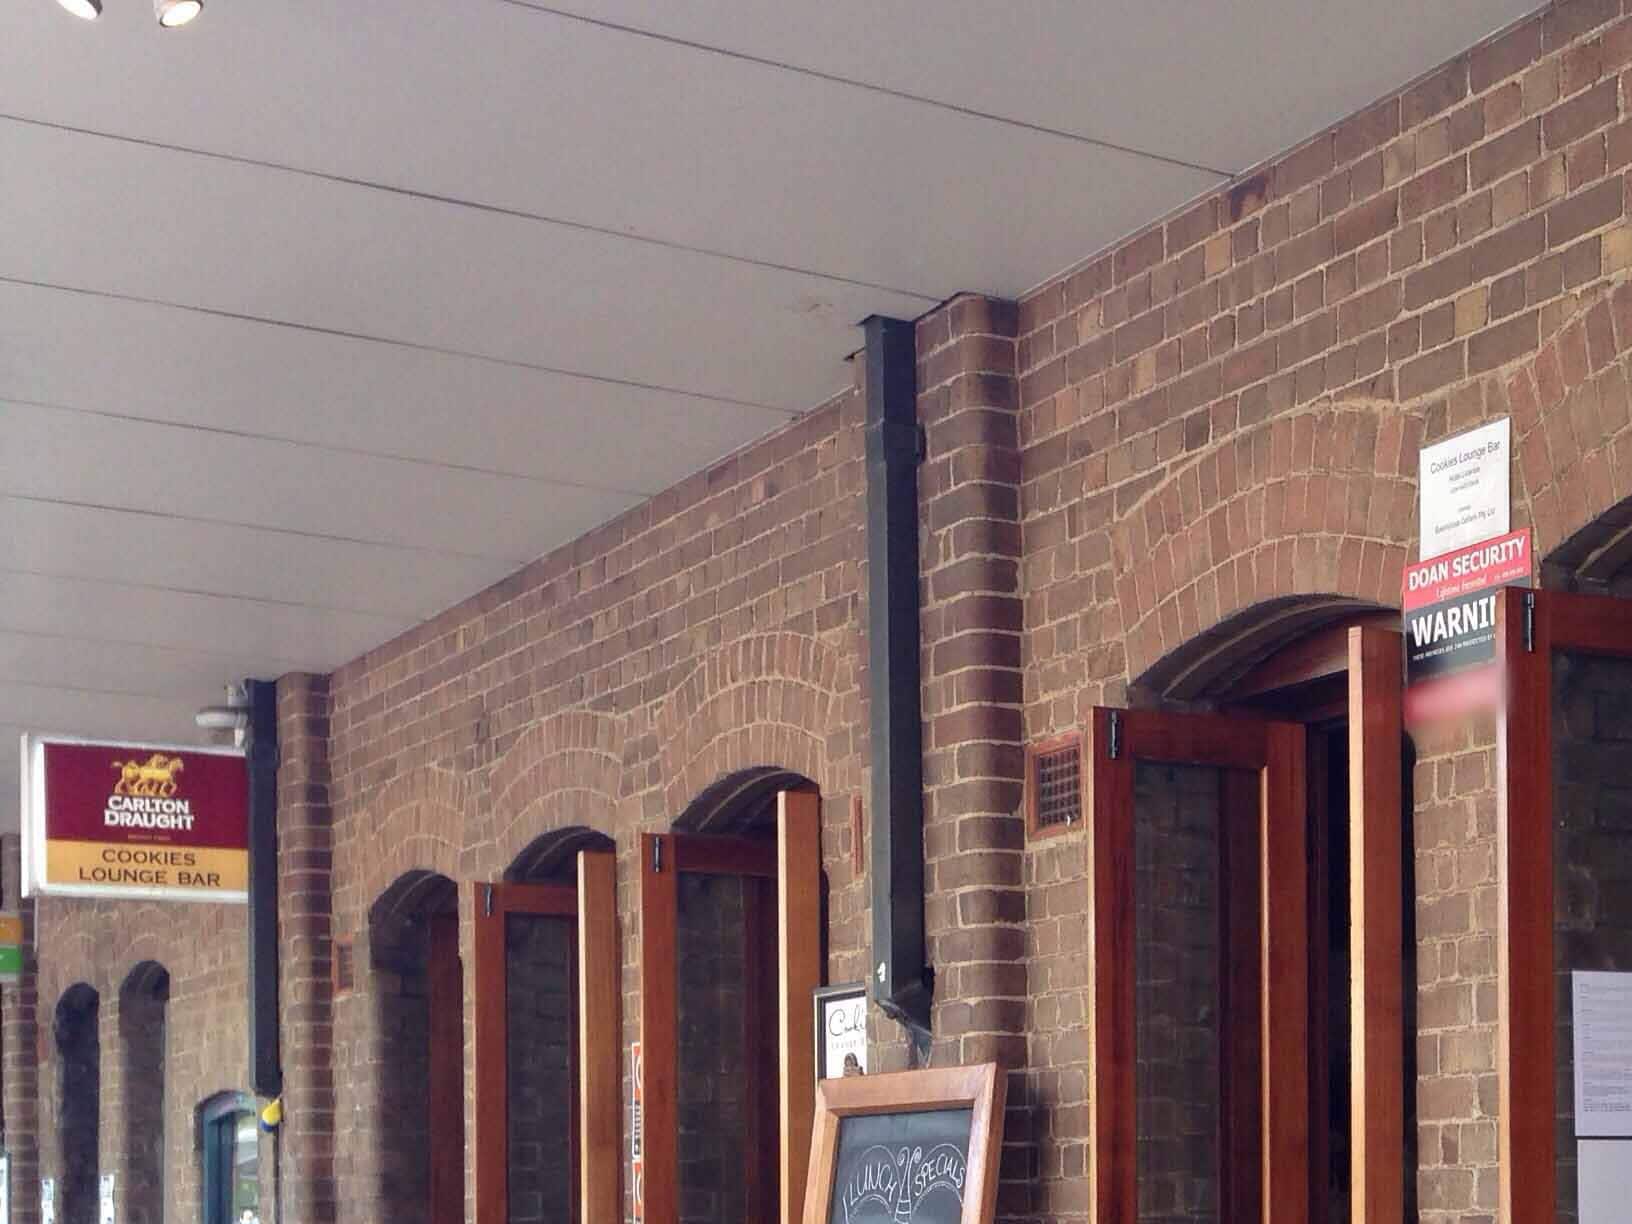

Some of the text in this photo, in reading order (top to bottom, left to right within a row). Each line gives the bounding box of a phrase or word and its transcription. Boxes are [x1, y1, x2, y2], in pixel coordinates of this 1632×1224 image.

[1431, 441, 1500, 474] Cookies Lounge Bar
[1408, 561, 1449, 592] DOAN
[1452, 536, 1526, 577] SECURITY
[108, 795, 190, 814] CARLTON
[104, 809, 195, 830] DRAUGHT
[102, 848, 196, 867] COOKIES
[79, 866, 221, 887] LOUNGE BAR
[849, 1153, 965, 1206] LUNCH SPECIALS
